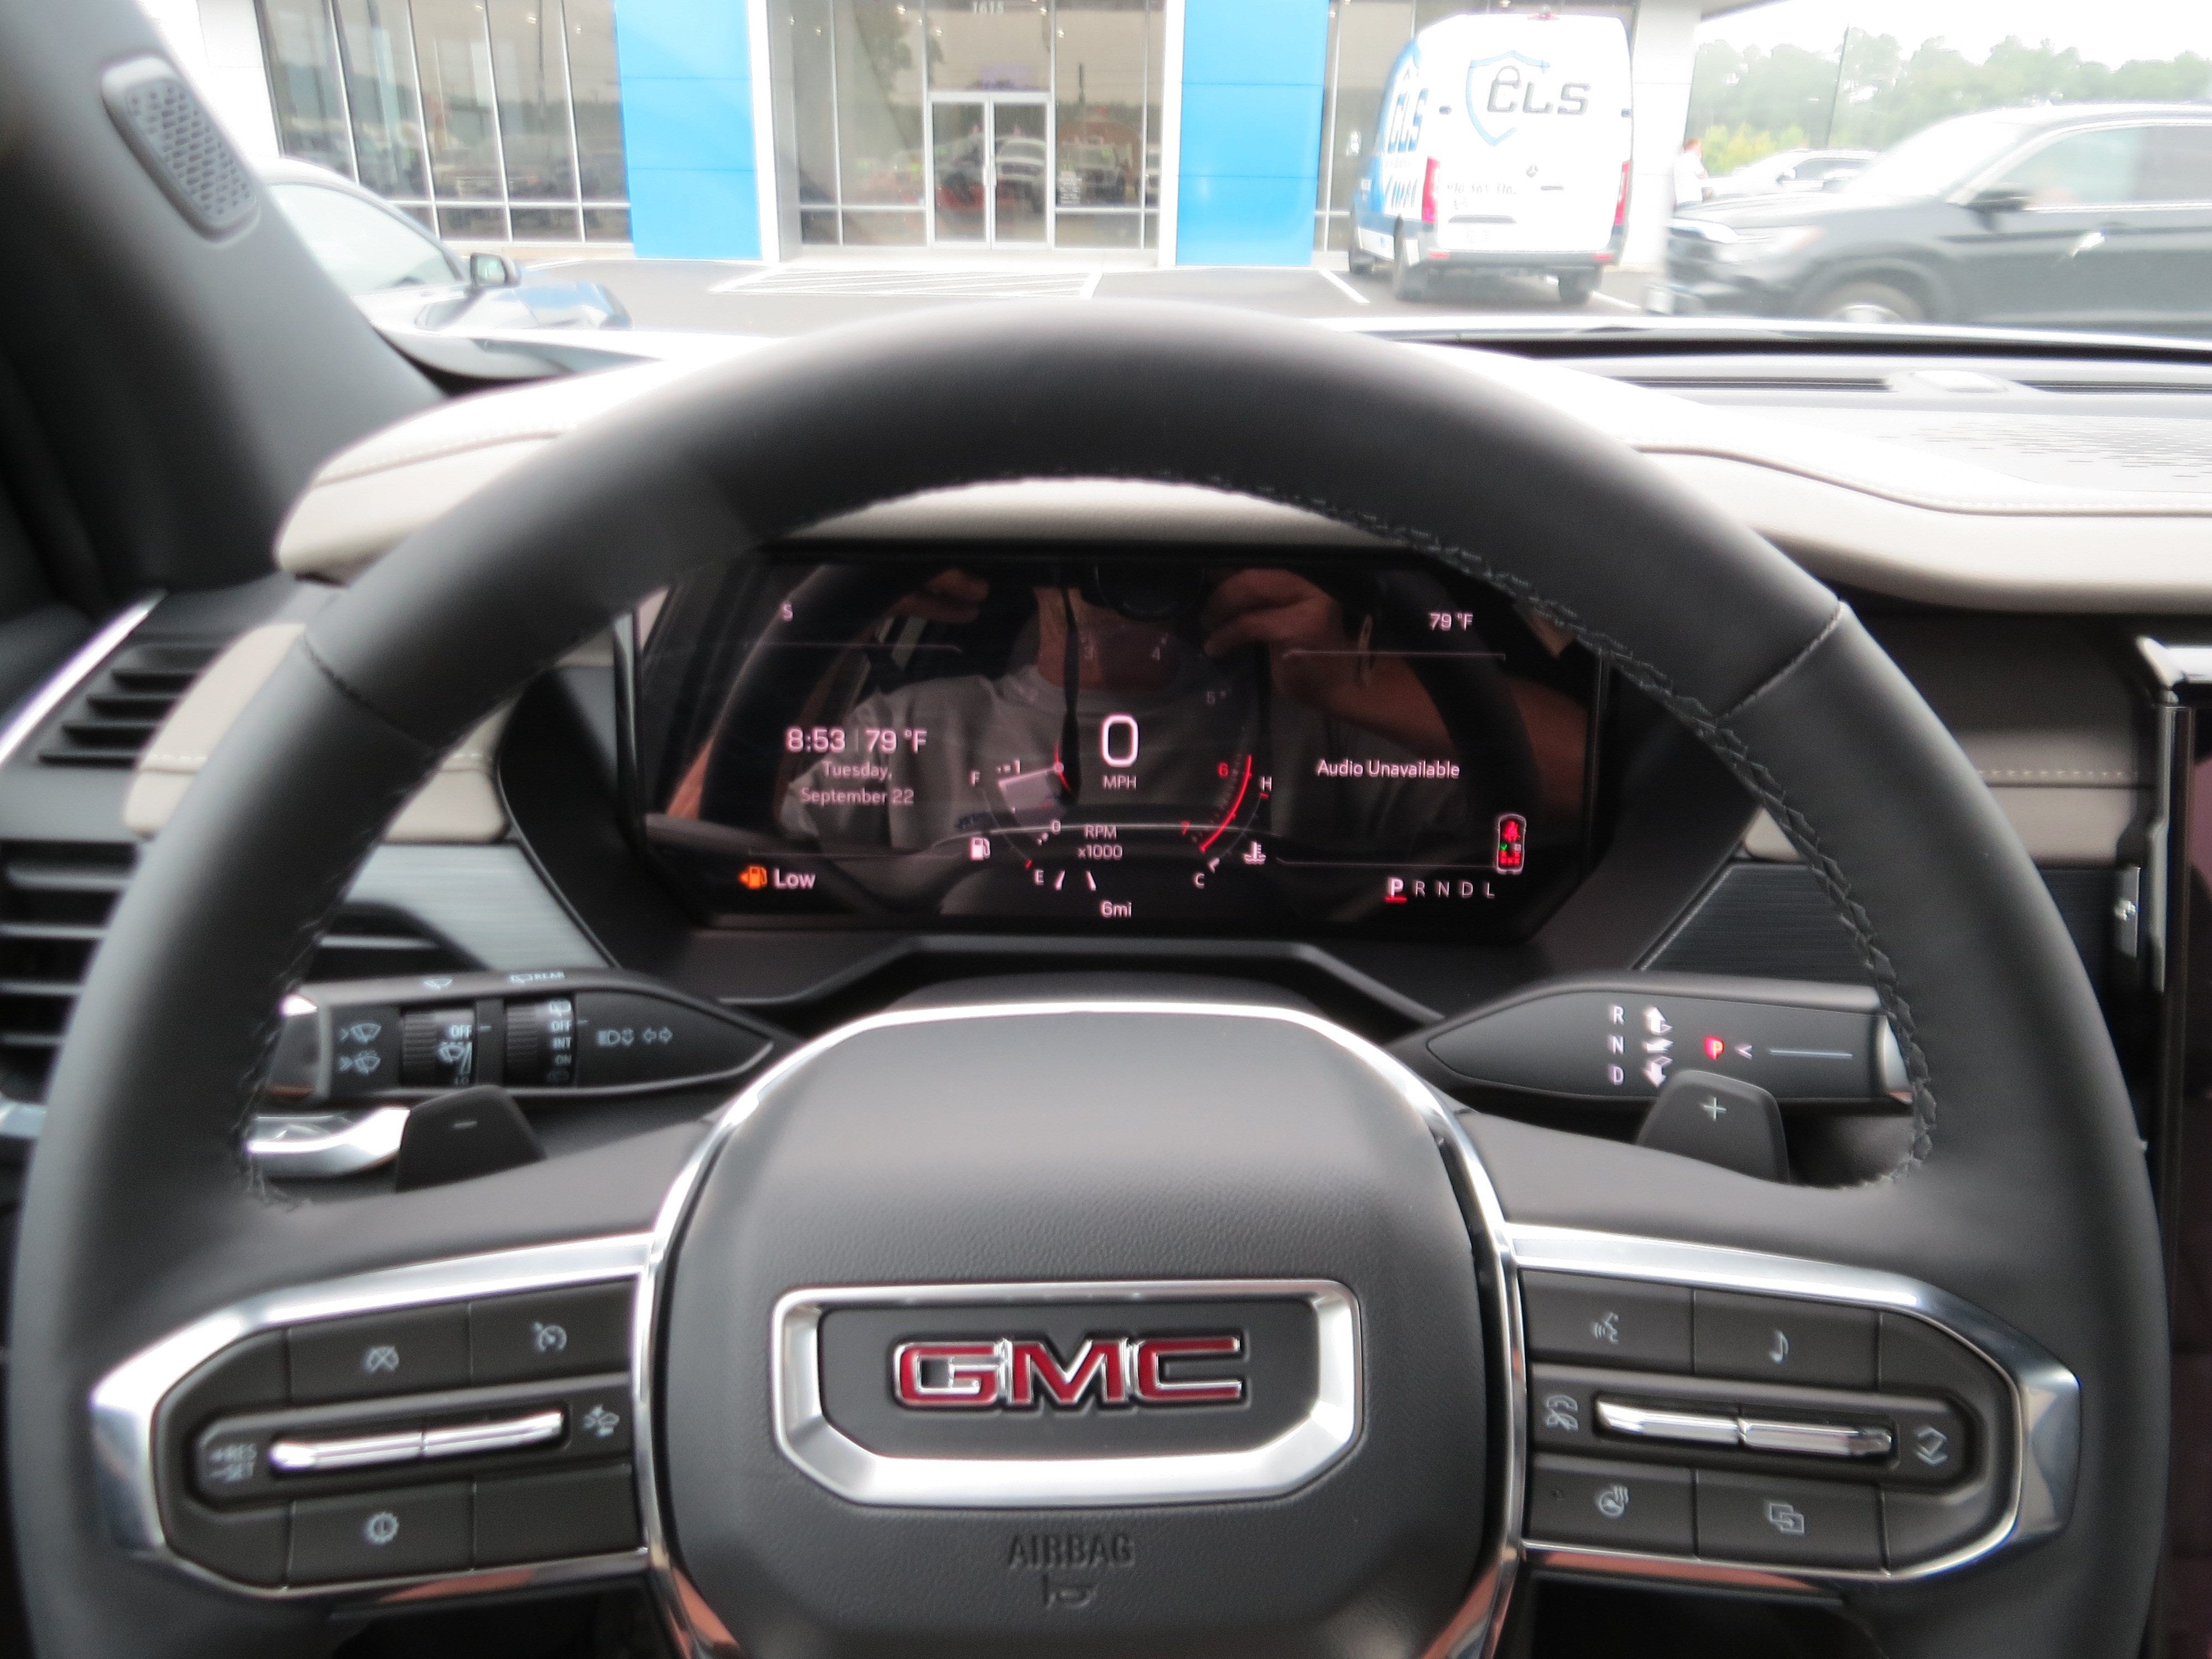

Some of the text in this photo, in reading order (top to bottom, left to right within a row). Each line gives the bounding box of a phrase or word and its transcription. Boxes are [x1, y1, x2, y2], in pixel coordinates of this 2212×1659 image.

[780, 602, 793, 621] S
[1428, 612, 1452, 631] 79
[785, 726, 846, 753] 8:53
[864, 727, 898, 754] 79
[1100, 714, 1139, 768] 0
[822, 761, 893, 781] Tuesday,
[970, 771, 980, 786] F
[1316, 759, 1460, 779] Audio Unavailable
[1103, 775, 1137, 790] MPH
[1260, 775, 1272, 792] H
[800, 787, 914, 807] September 22
[1084, 825, 1117, 839] RPM
[1078, 844, 1123, 859] x1000
[774, 868, 816, 889] Low
[1034, 868, 1044, 885] E
[1193, 872, 1205, 889] C
[1389, 878, 1495, 898] P R N D L
[1609, 1004, 1625, 1024] R
[1609, 1035, 1625, 1055] N
[1609, 1065, 1625, 1086] D
[892, 1336, 1243, 1408] GMC
[1008, 1533, 1135, 1568] AIRBAG
